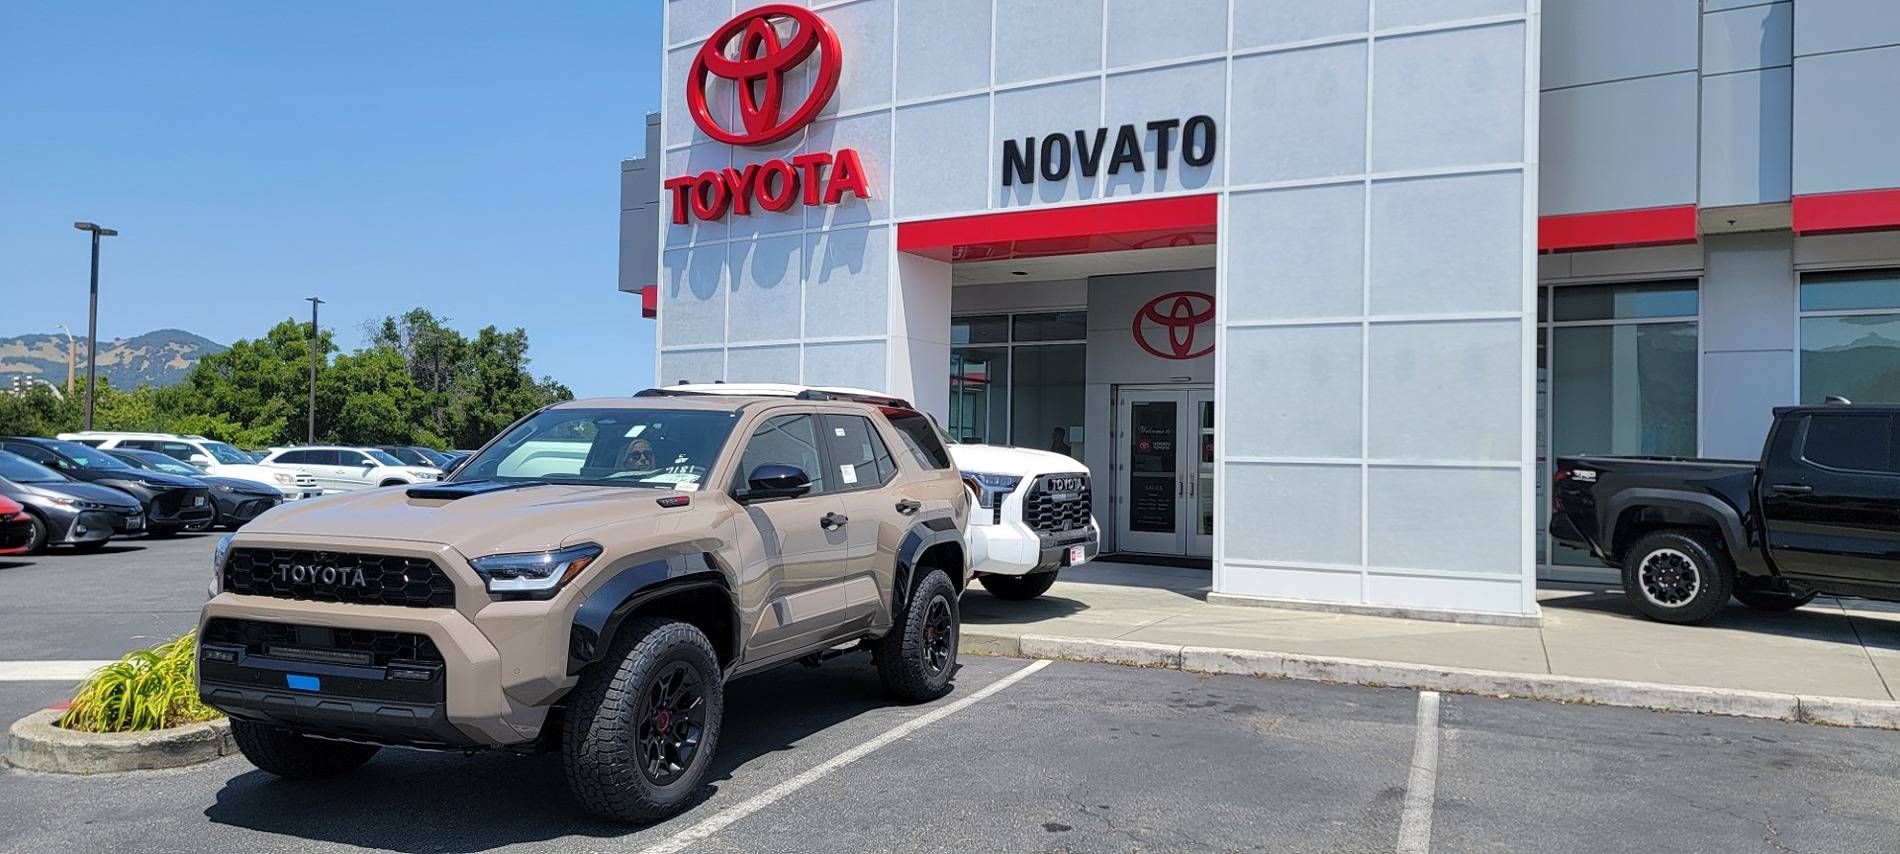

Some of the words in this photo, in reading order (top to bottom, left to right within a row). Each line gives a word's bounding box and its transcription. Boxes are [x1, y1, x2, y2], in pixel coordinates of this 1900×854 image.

[1002, 115, 1217, 186] NOVATO
[664, 148, 872, 225] TOYOTA
[665, 465, 695, 474] 7181
[1051, 478, 1083, 490] TOYOTA
[278, 563, 366, 587] TOYOTA
